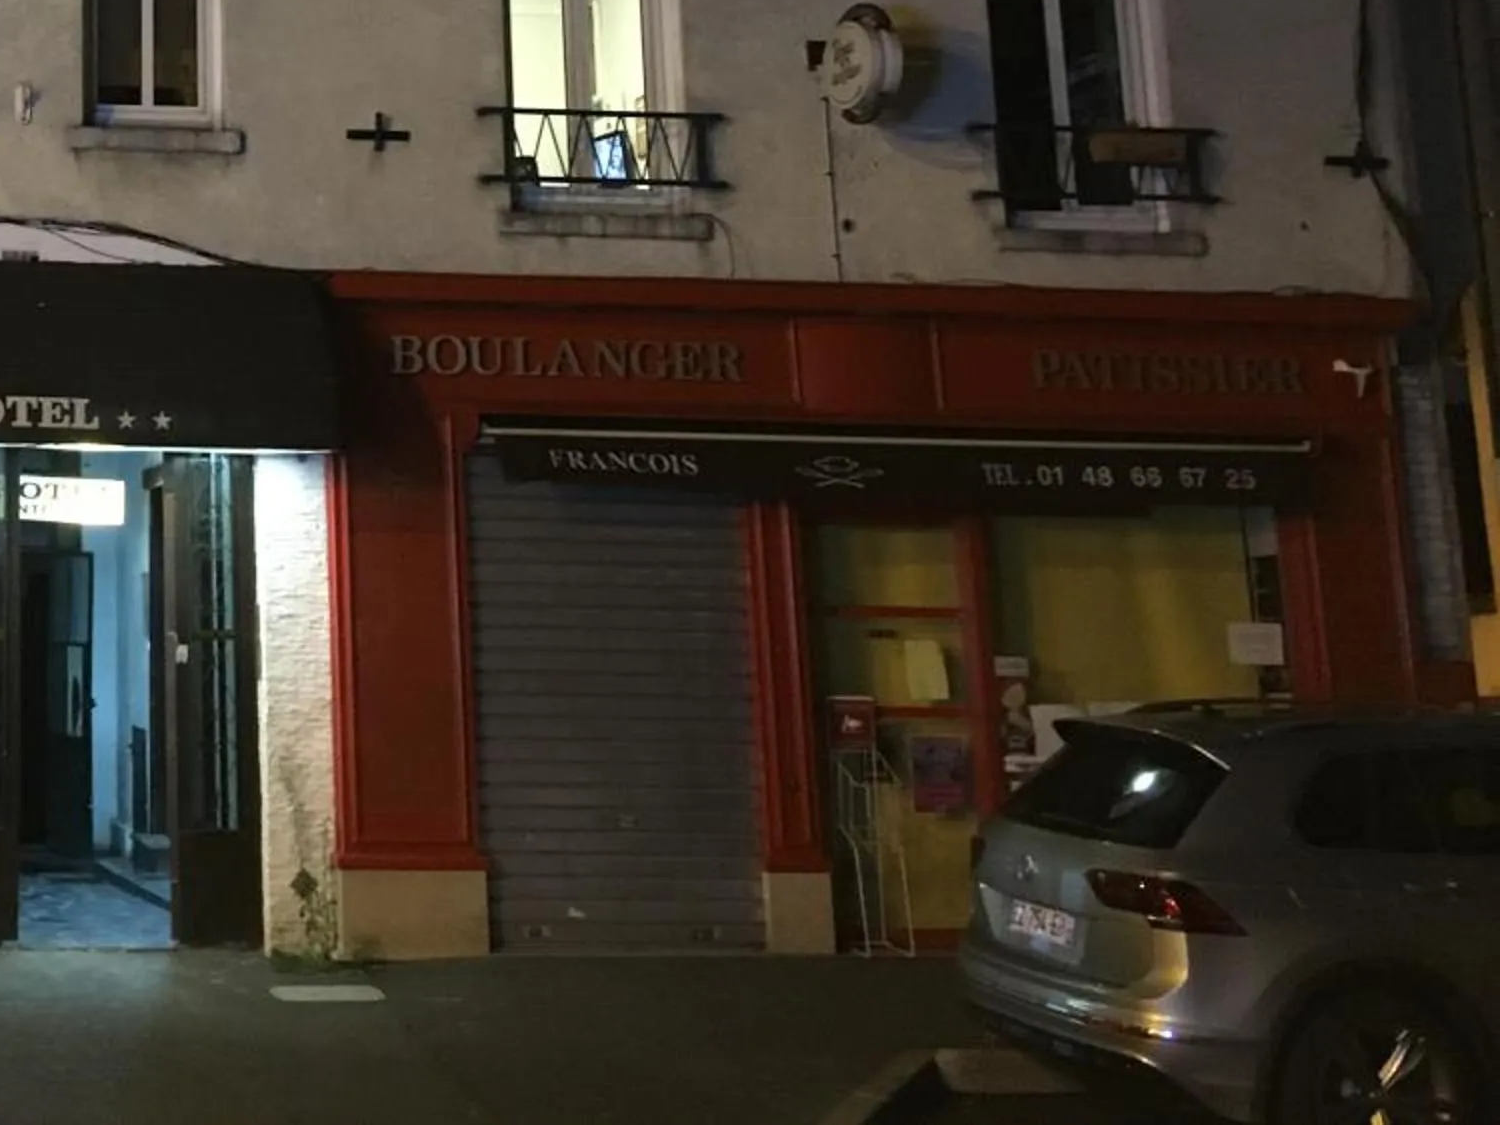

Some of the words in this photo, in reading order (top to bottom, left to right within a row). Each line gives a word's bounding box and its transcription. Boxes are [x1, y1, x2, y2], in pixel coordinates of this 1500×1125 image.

[391, 334, 742, 382] BOULANGER
[548, 448, 700, 476] FRANCOIS
[1080, 464, 1115, 488] 48
